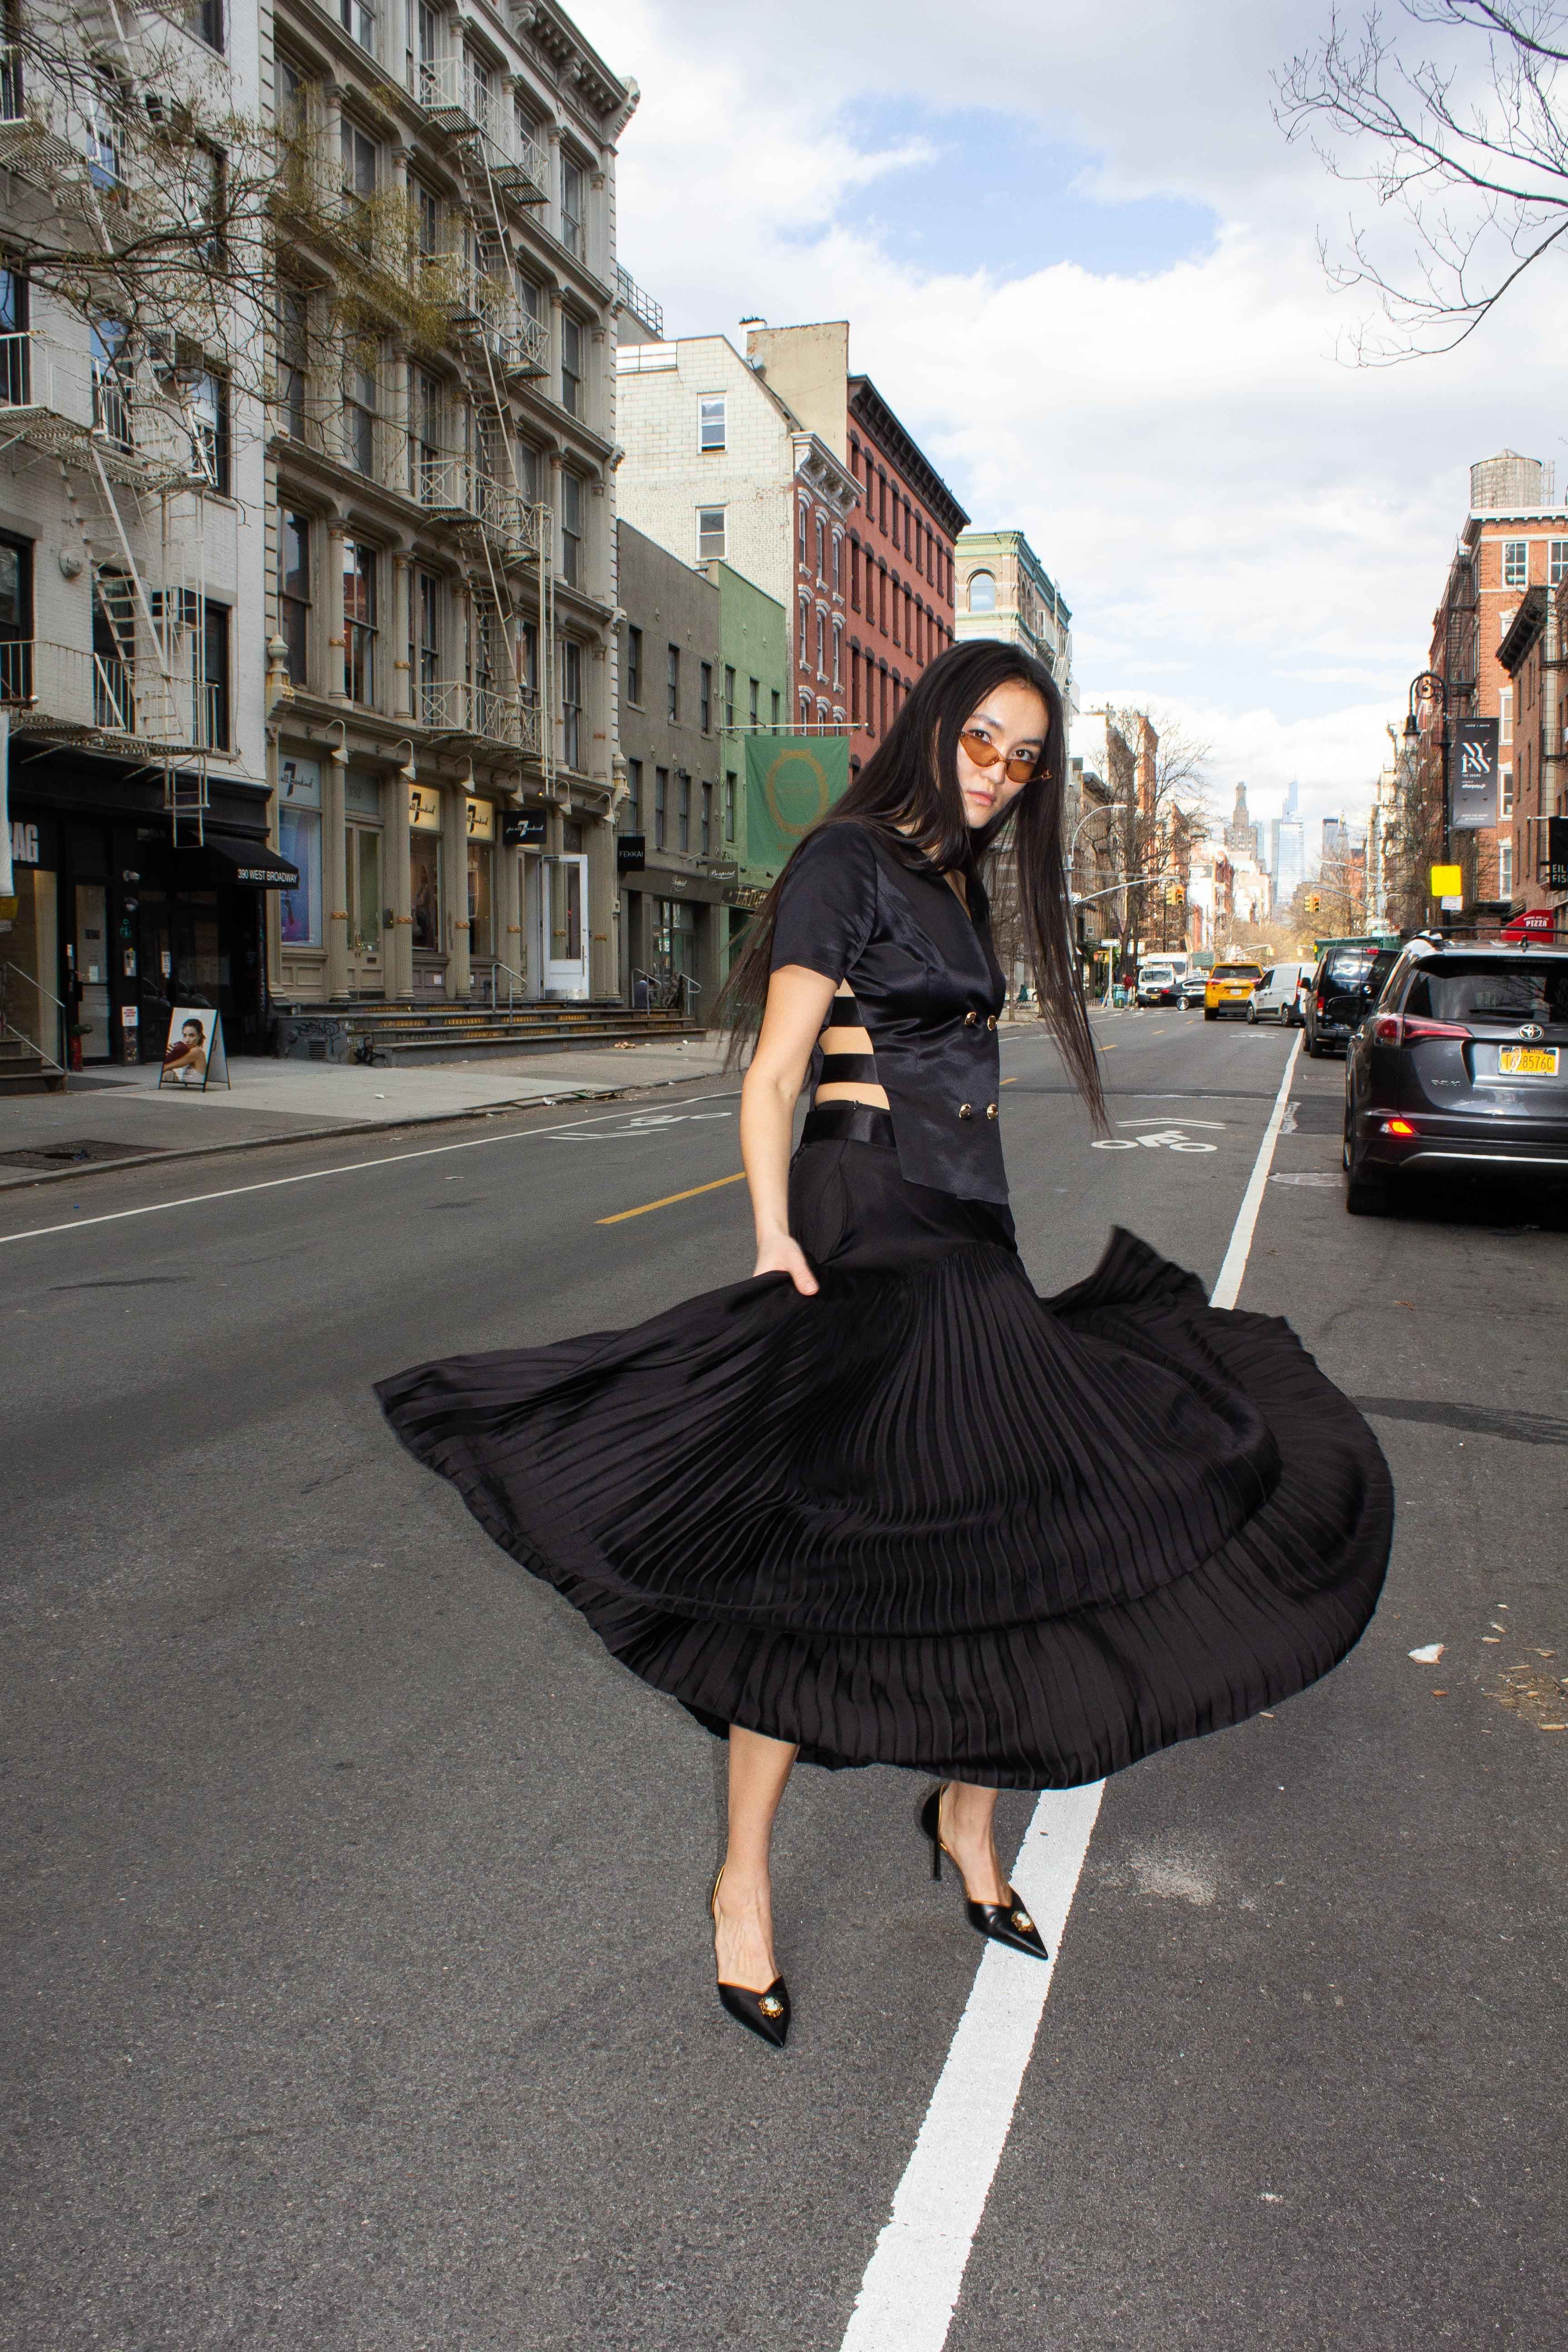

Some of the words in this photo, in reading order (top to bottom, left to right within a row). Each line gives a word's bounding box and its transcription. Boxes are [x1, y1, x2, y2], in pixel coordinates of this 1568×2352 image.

[8, 822, 39, 862] AG
[1552, 864, 1568, 873] EIL
[238, 868, 248, 879] 390
[249, 869, 265, 880] WEST
[266, 871, 298, 882] BROADWAY
[1552, 874, 1568, 883] FIS
